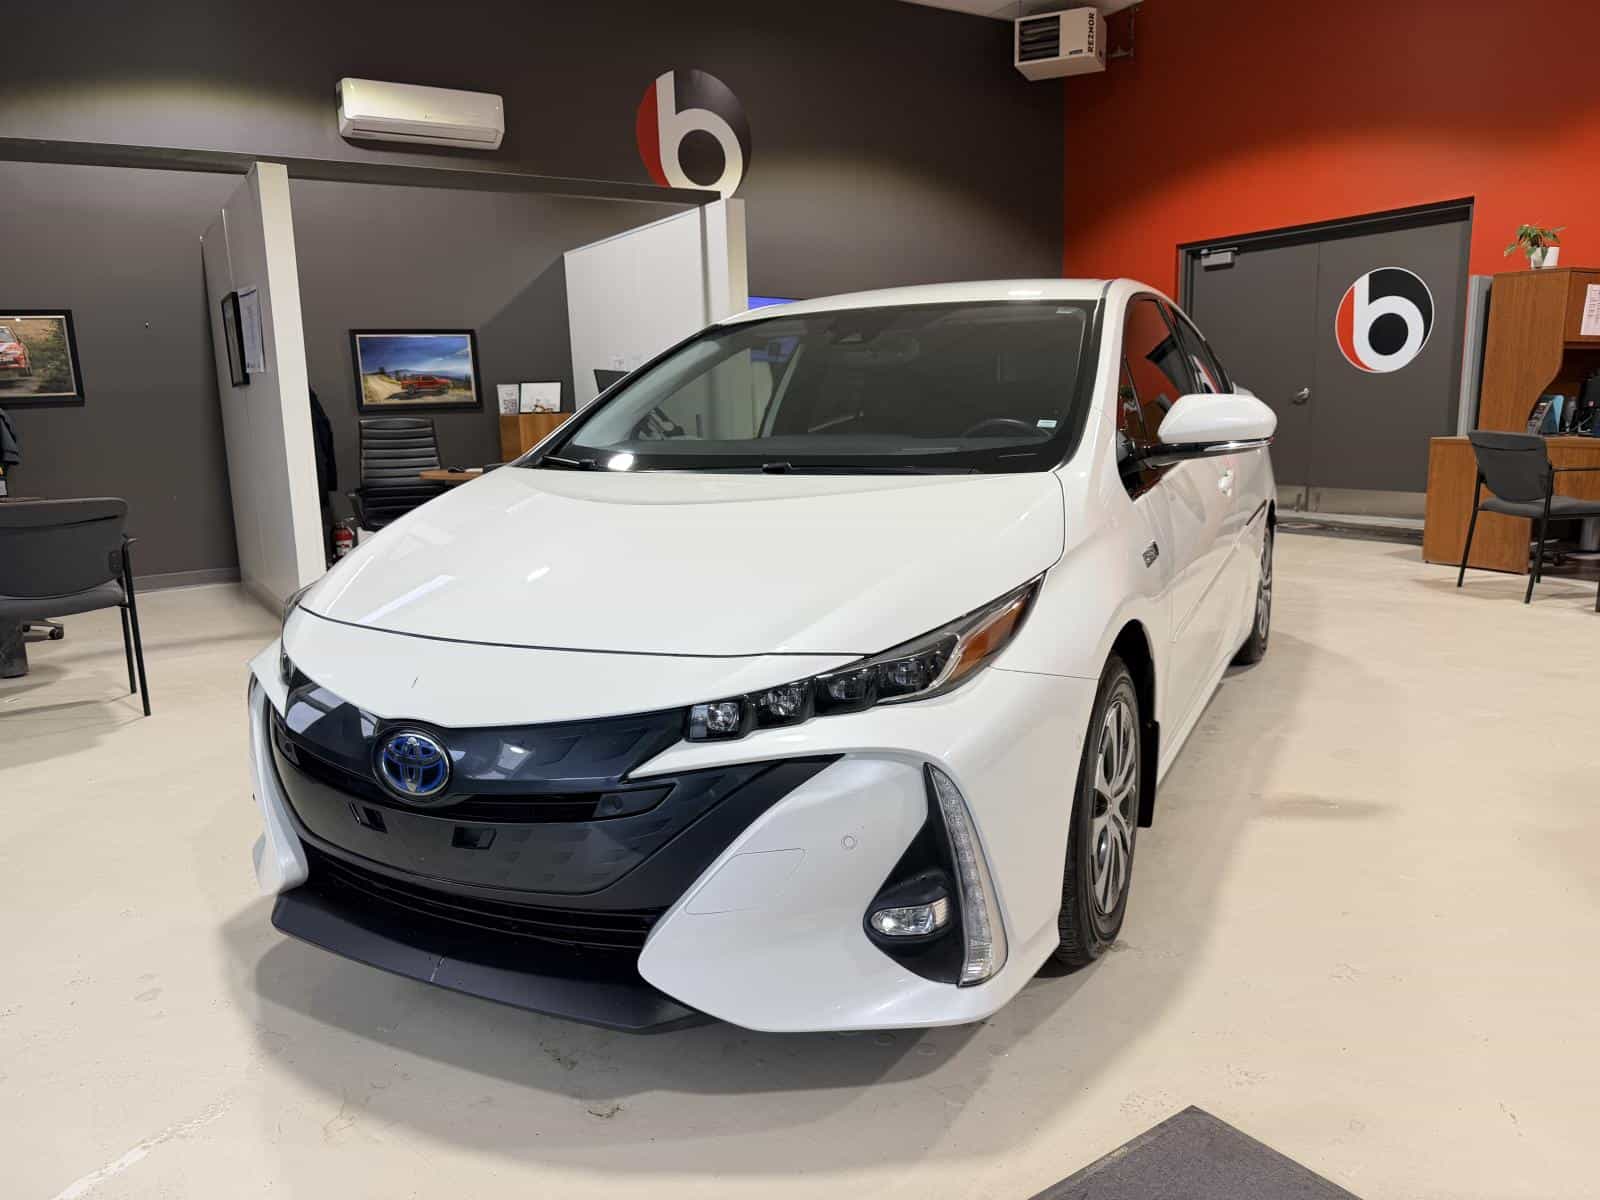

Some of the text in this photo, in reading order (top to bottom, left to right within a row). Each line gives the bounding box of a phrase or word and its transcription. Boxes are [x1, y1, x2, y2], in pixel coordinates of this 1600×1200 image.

[1087, 12, 1095, 53] REZNOR
[655, 69, 743, 199] b
[1352, 271, 1425, 373] b
